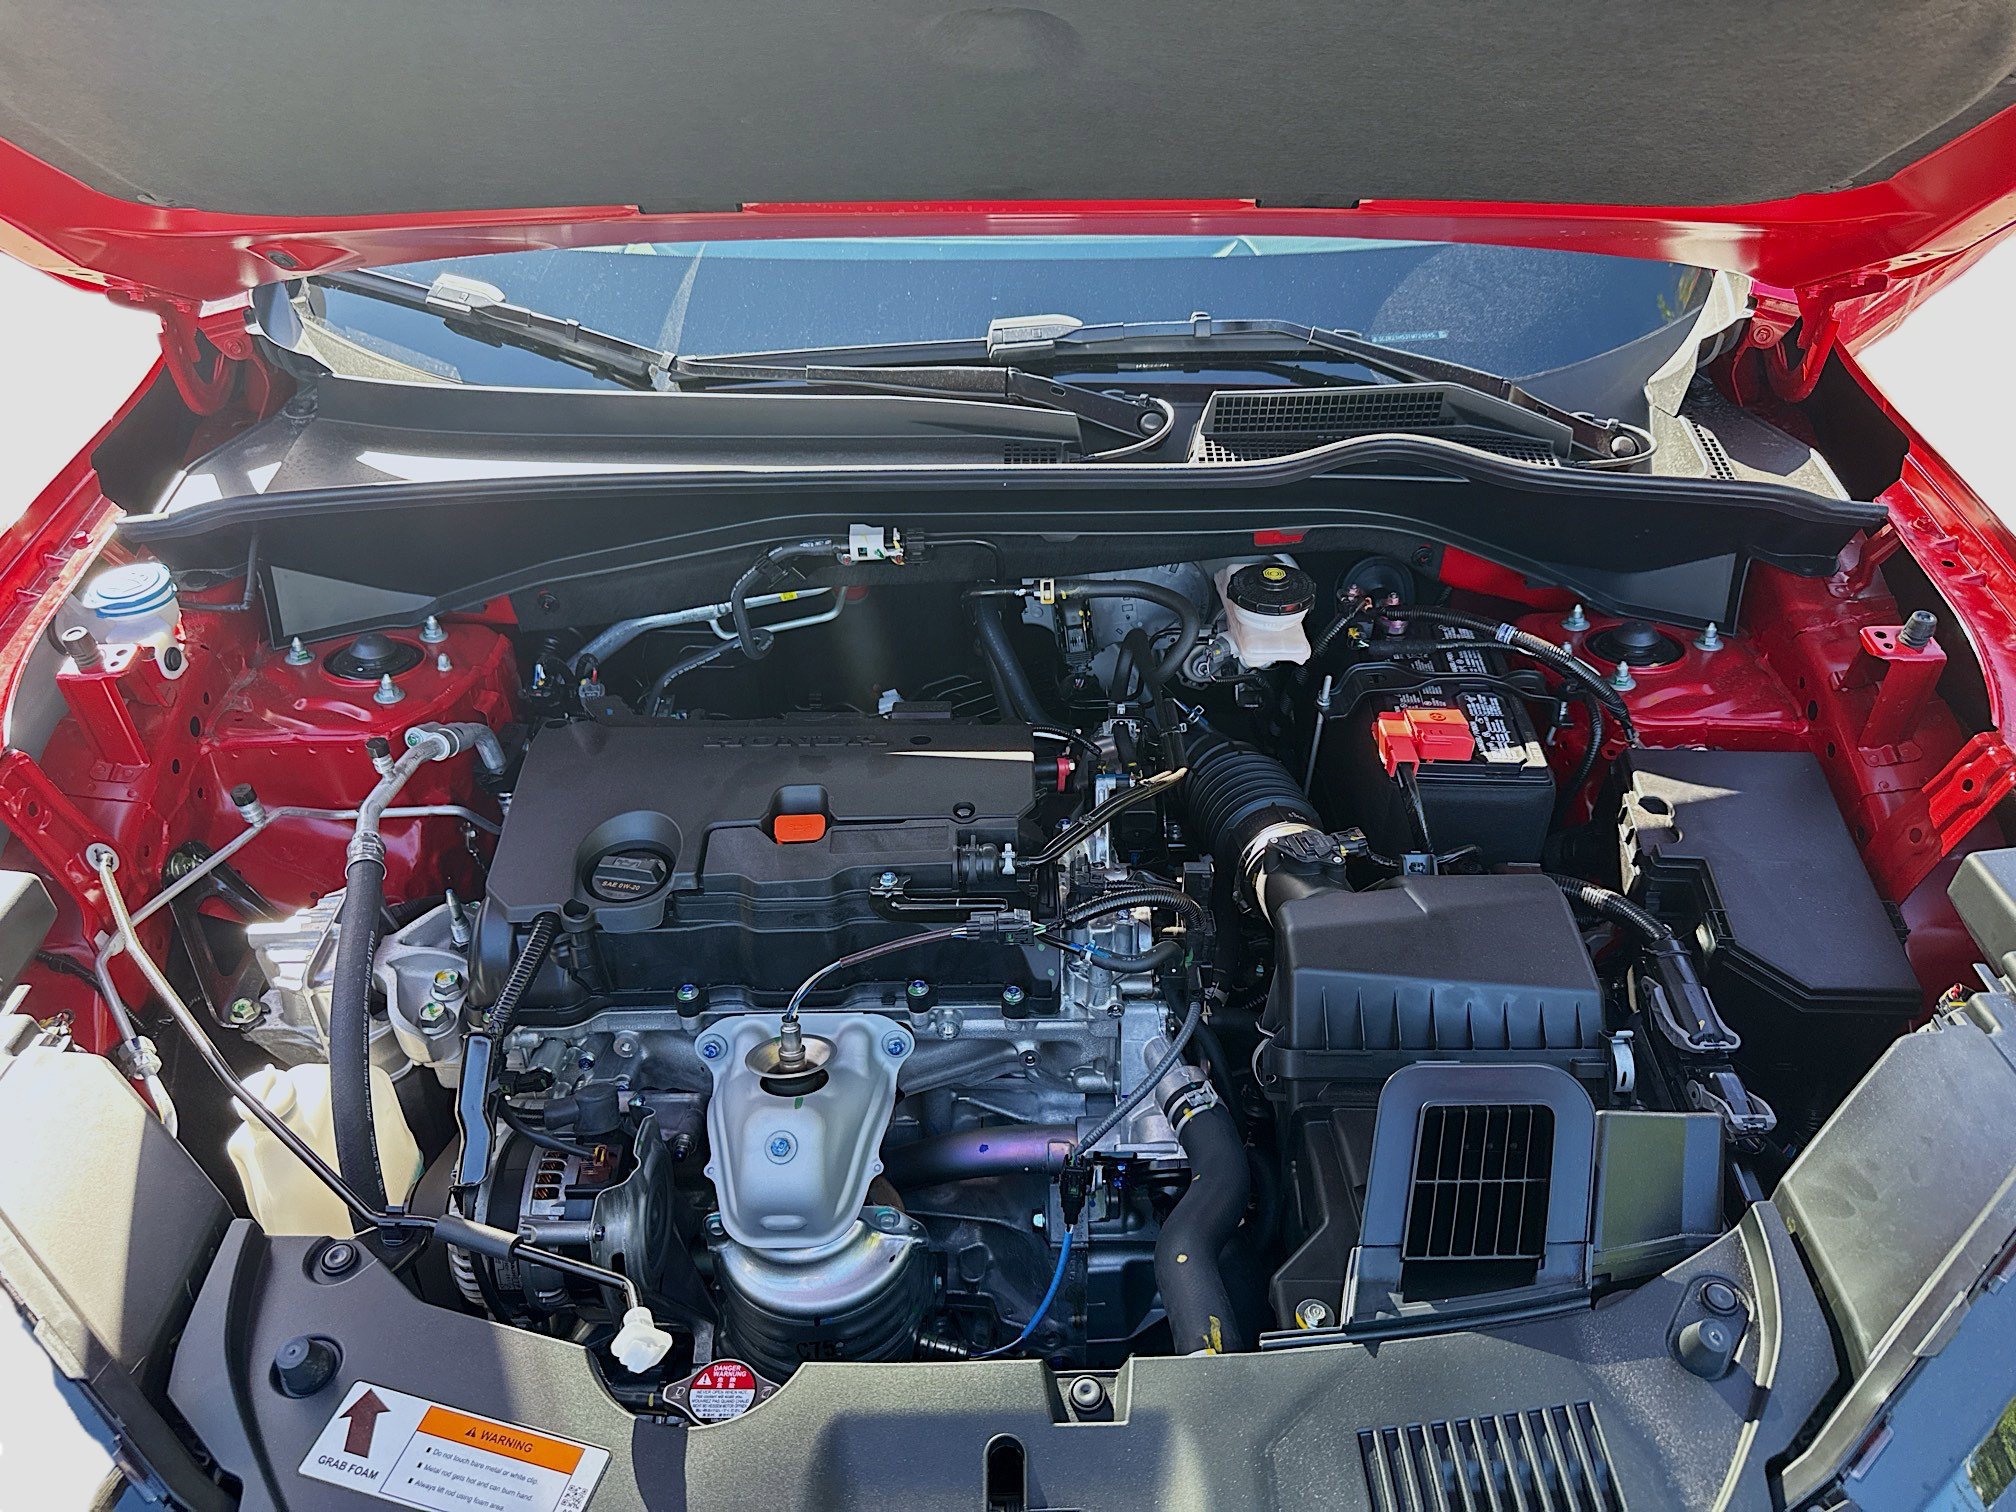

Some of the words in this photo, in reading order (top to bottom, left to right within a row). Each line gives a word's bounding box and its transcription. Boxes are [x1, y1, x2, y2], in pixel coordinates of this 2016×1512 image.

[601, 880, 617, 888] SAE
[618, 883, 641, 891] 0W-20
[480, 1430, 534, 1453] WARNING
[318, 1455, 348, 1471] GRAB
[347, 1464, 380, 1480] FOAM
[432, 1448, 443, 1457] Do
[453, 1455, 470, 1465] touch
[470, 1460, 485, 1469] bare
[485, 1465, 501, 1474] metal
[509, 1471, 526, 1481] white
[423, 1464, 440, 1474] Metal
[440, 1470, 453, 1478] rod
[451, 1474, 466, 1482] gets
[466, 1476, 476, 1484] hot
[476, 1480, 490, 1489] and
[489, 1484, 501, 1492] can
[501, 1486, 516, 1496] burn
[414, 1480, 436, 1491] Always
[436, 1486, 445, 1494] lift
[444, 1489, 457, 1497] rod
[455, 1493, 473, 1504] using
[473, 1497, 490, 1506] foam
